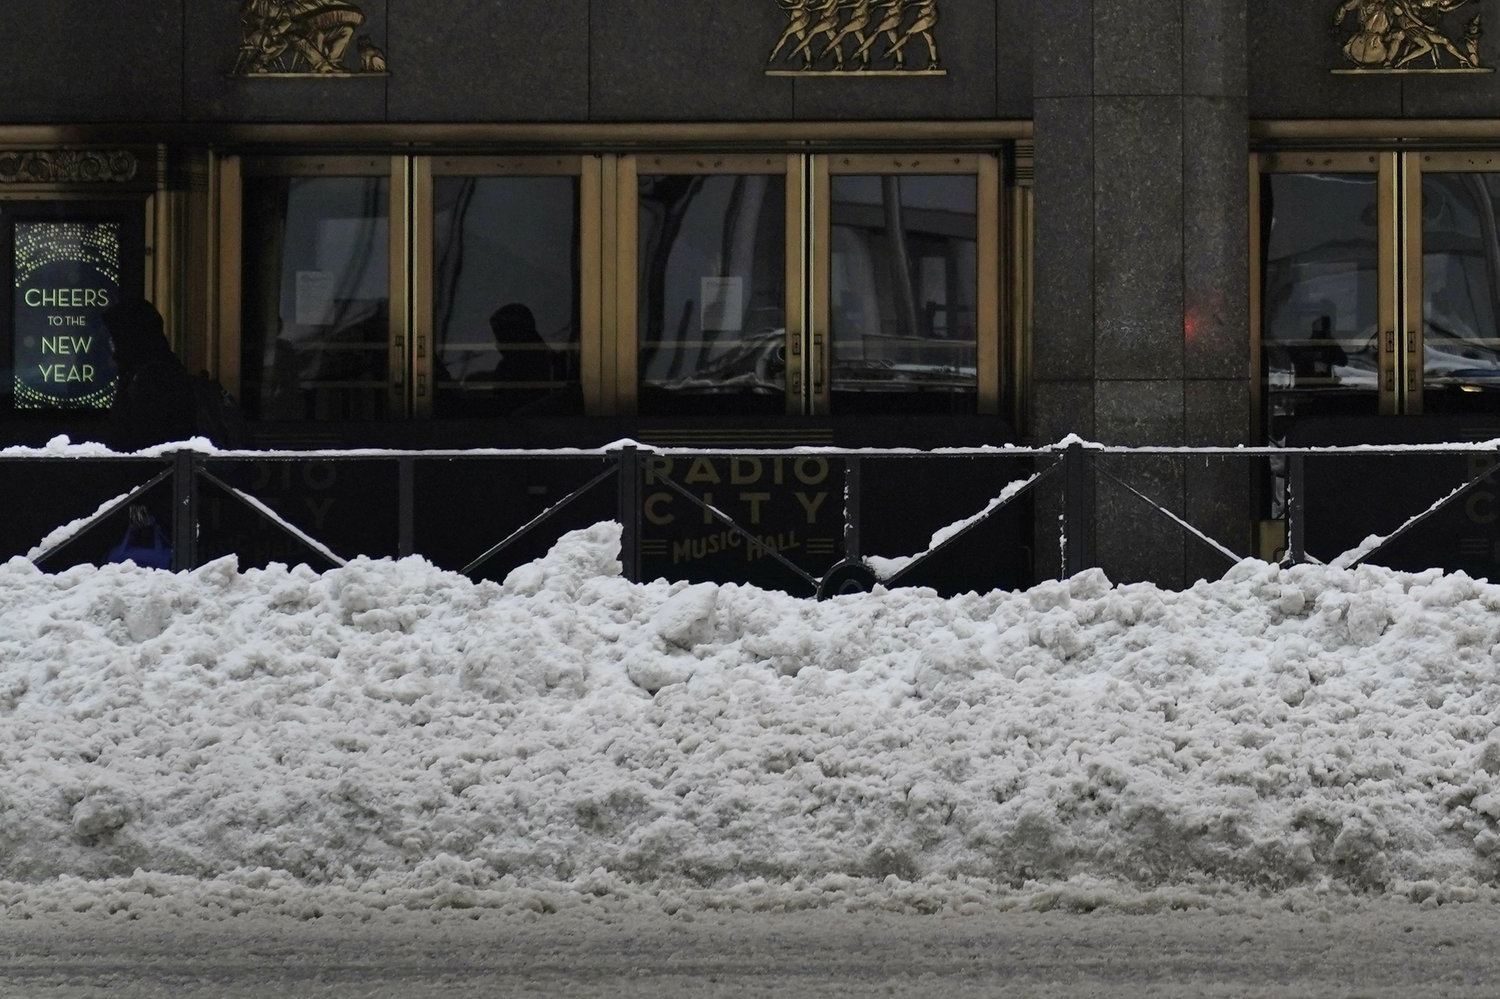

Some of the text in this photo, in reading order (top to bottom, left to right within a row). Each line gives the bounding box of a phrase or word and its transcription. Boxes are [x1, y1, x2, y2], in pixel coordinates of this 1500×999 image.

[25, 288, 109, 307] CHEERS
[48, 316, 86, 326] TO THE
[42, 336, 92, 354] NEW
[38, 364, 94, 382] YEAR
[644, 492, 828, 525] CITY
[672, 531, 741, 564] MUSIC
